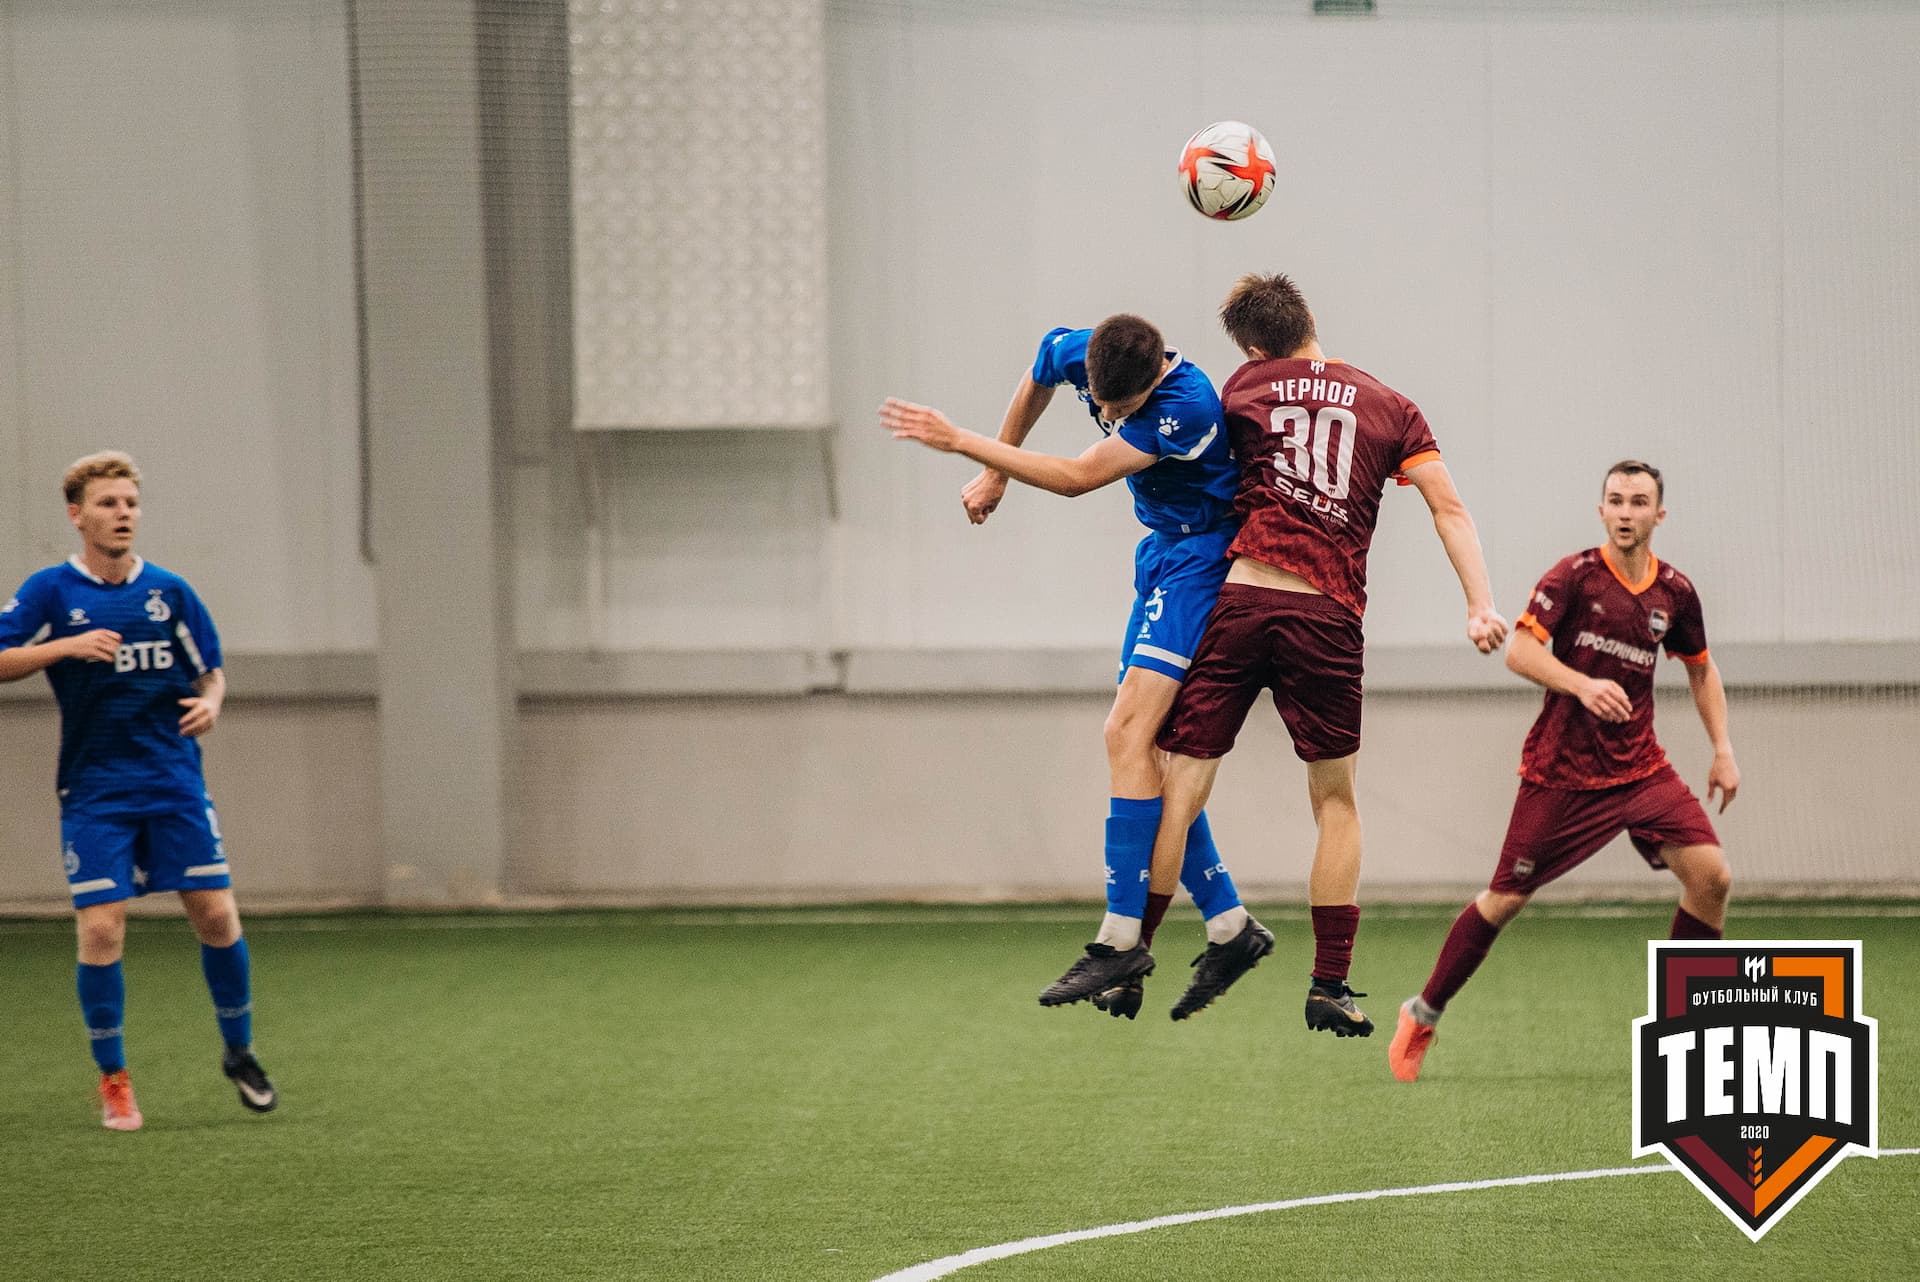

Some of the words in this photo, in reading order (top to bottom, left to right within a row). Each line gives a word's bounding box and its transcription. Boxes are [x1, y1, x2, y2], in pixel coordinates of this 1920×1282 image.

[1271, 378, 1357, 407] ЧЕРНОВ
[1270, 405, 1357, 500] 30
[114, 640, 174, 673] ВТБ
